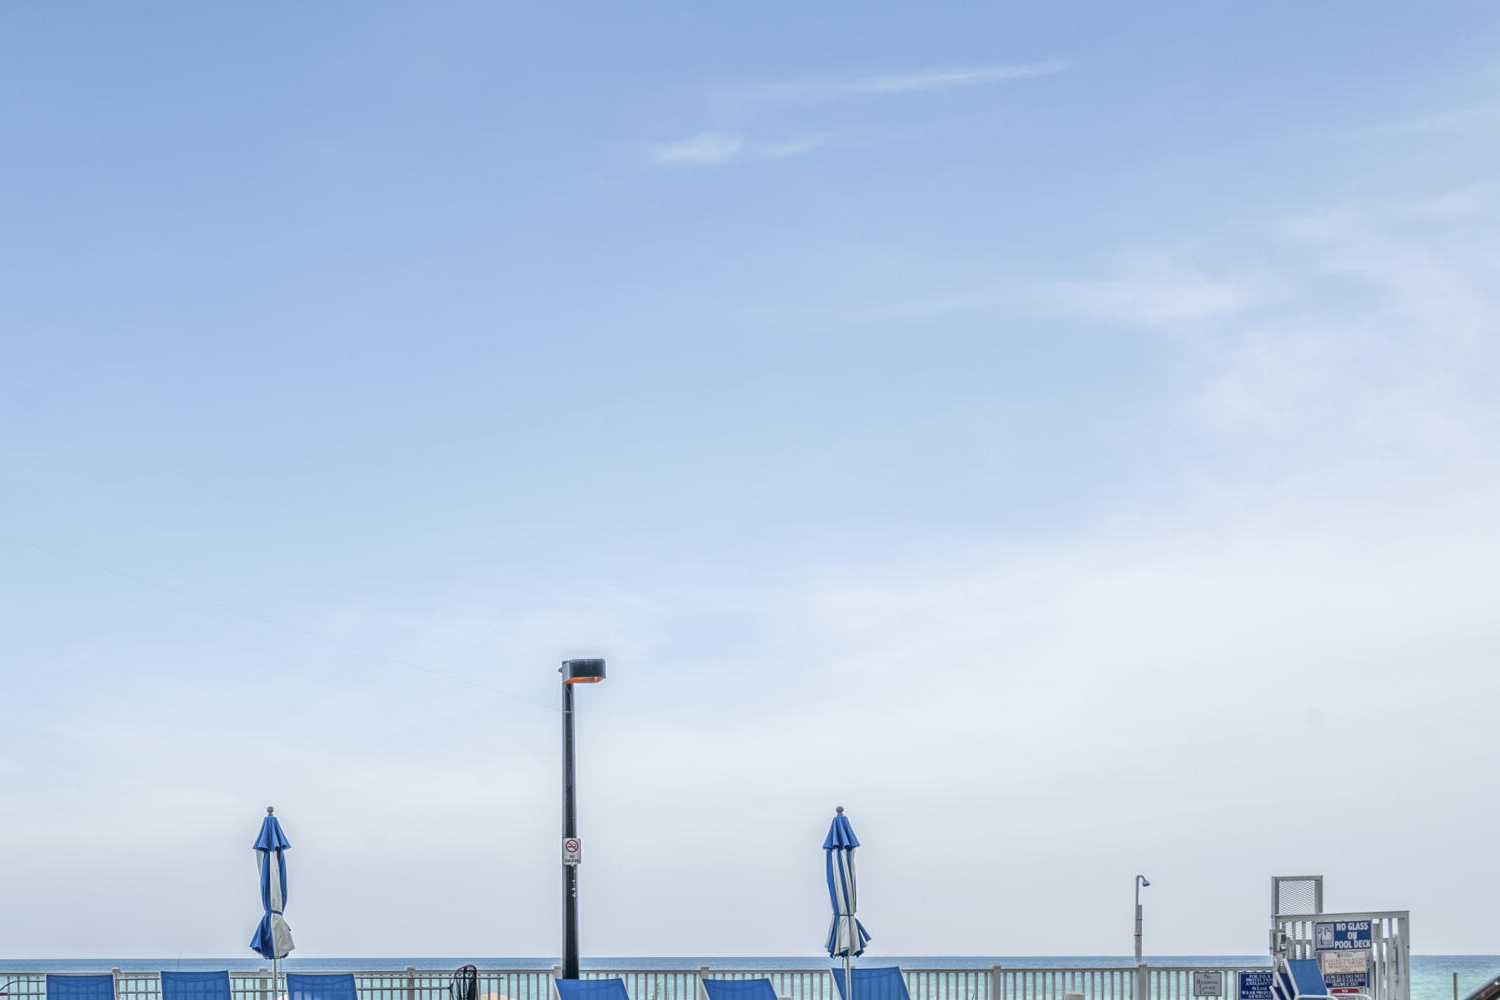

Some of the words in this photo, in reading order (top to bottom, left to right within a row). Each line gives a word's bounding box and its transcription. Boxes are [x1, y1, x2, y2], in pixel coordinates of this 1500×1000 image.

[1336, 923, 1346, 931] NO
[1347, 922, 1369, 930] GLASS
[1347, 931, 1358, 940] ON
[1334, 940, 1353, 949] POOL
[1354, 939, 1371, 948] DECK
